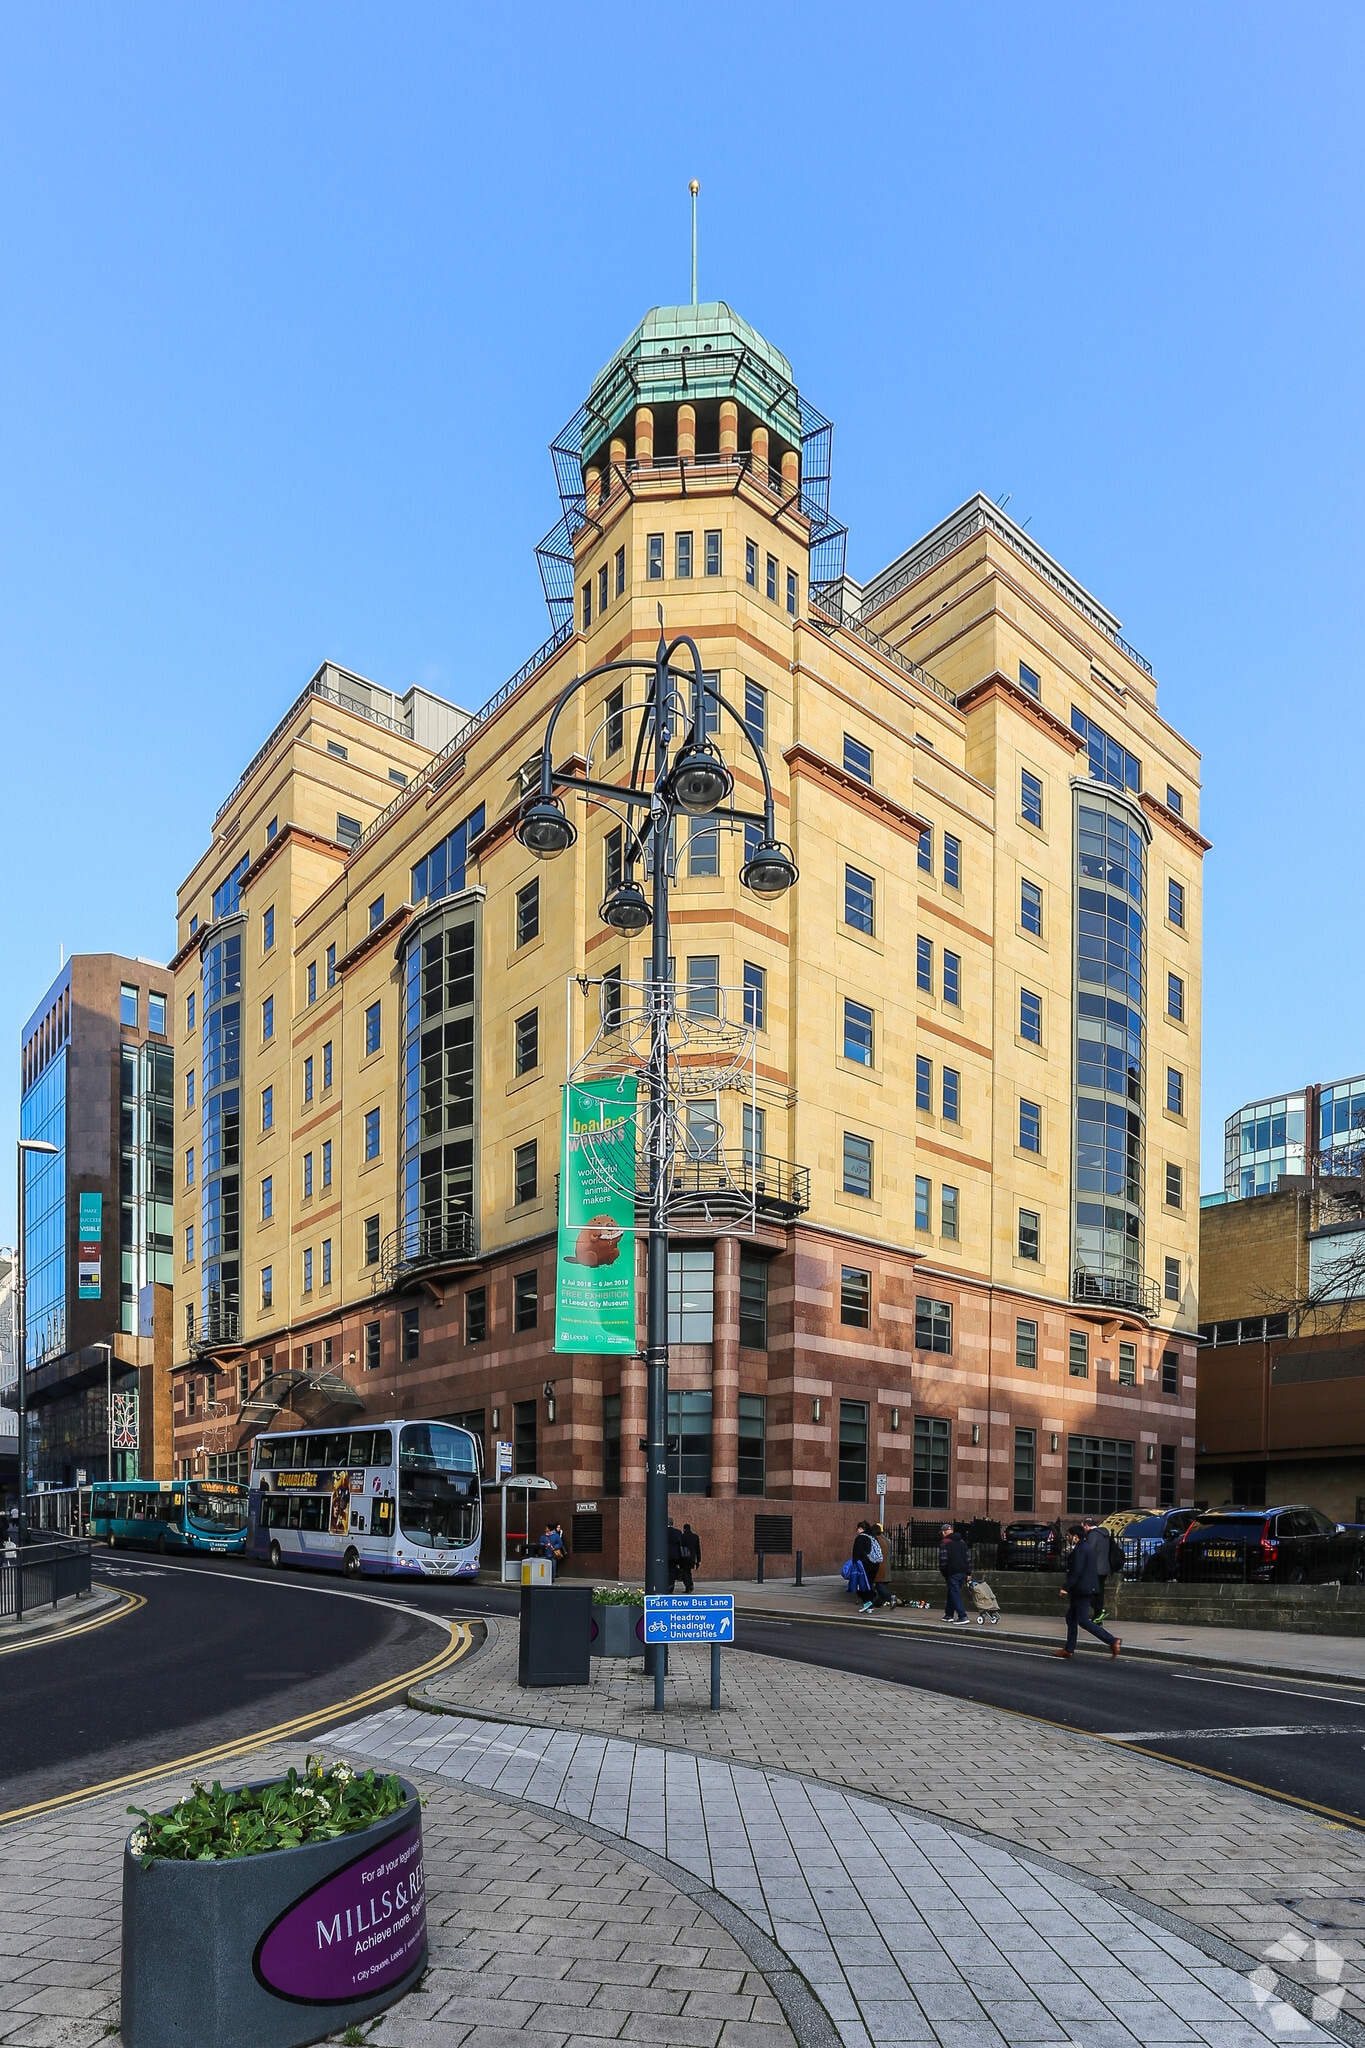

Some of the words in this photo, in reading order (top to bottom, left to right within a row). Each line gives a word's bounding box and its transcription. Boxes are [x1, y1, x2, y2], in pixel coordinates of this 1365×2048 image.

[577, 1164, 618, 1177] wonderful
[582, 1195, 612, 1205] makers
[561, 1289, 582, 1298] FREE
[584, 1291, 629, 1299] EXHIBITION
[589, 1300, 602, 1308] City
[569, 1333, 589, 1341] Leeds
[277, 1472, 318, 1487] BUMBLEBEE
[650, 1599, 669, 1607] Park
[671, 1599, 689, 1607] Row
[692, 1598, 707, 1607] Bus
[710, 1598, 729, 1606] Lane
[670, 1613, 707, 1621] Headrow
[670, 1622, 715, 1631] Headingley
[361, 1872, 375, 1885] For
[376, 1864, 385, 1877] all
[385, 1858, 399, 1875] your
[400, 1847, 410, 1863] legal
[316, 1890, 392, 1949] MILLS
[395, 1882, 409, 1910] &
[354, 1927, 392, 1956] Achieve
[393, 1913, 412, 1934] more.
[352, 1975, 356, 1984] 1
[357, 1970, 370, 1981] City
[390, 1947, 404, 1961] Leeds
